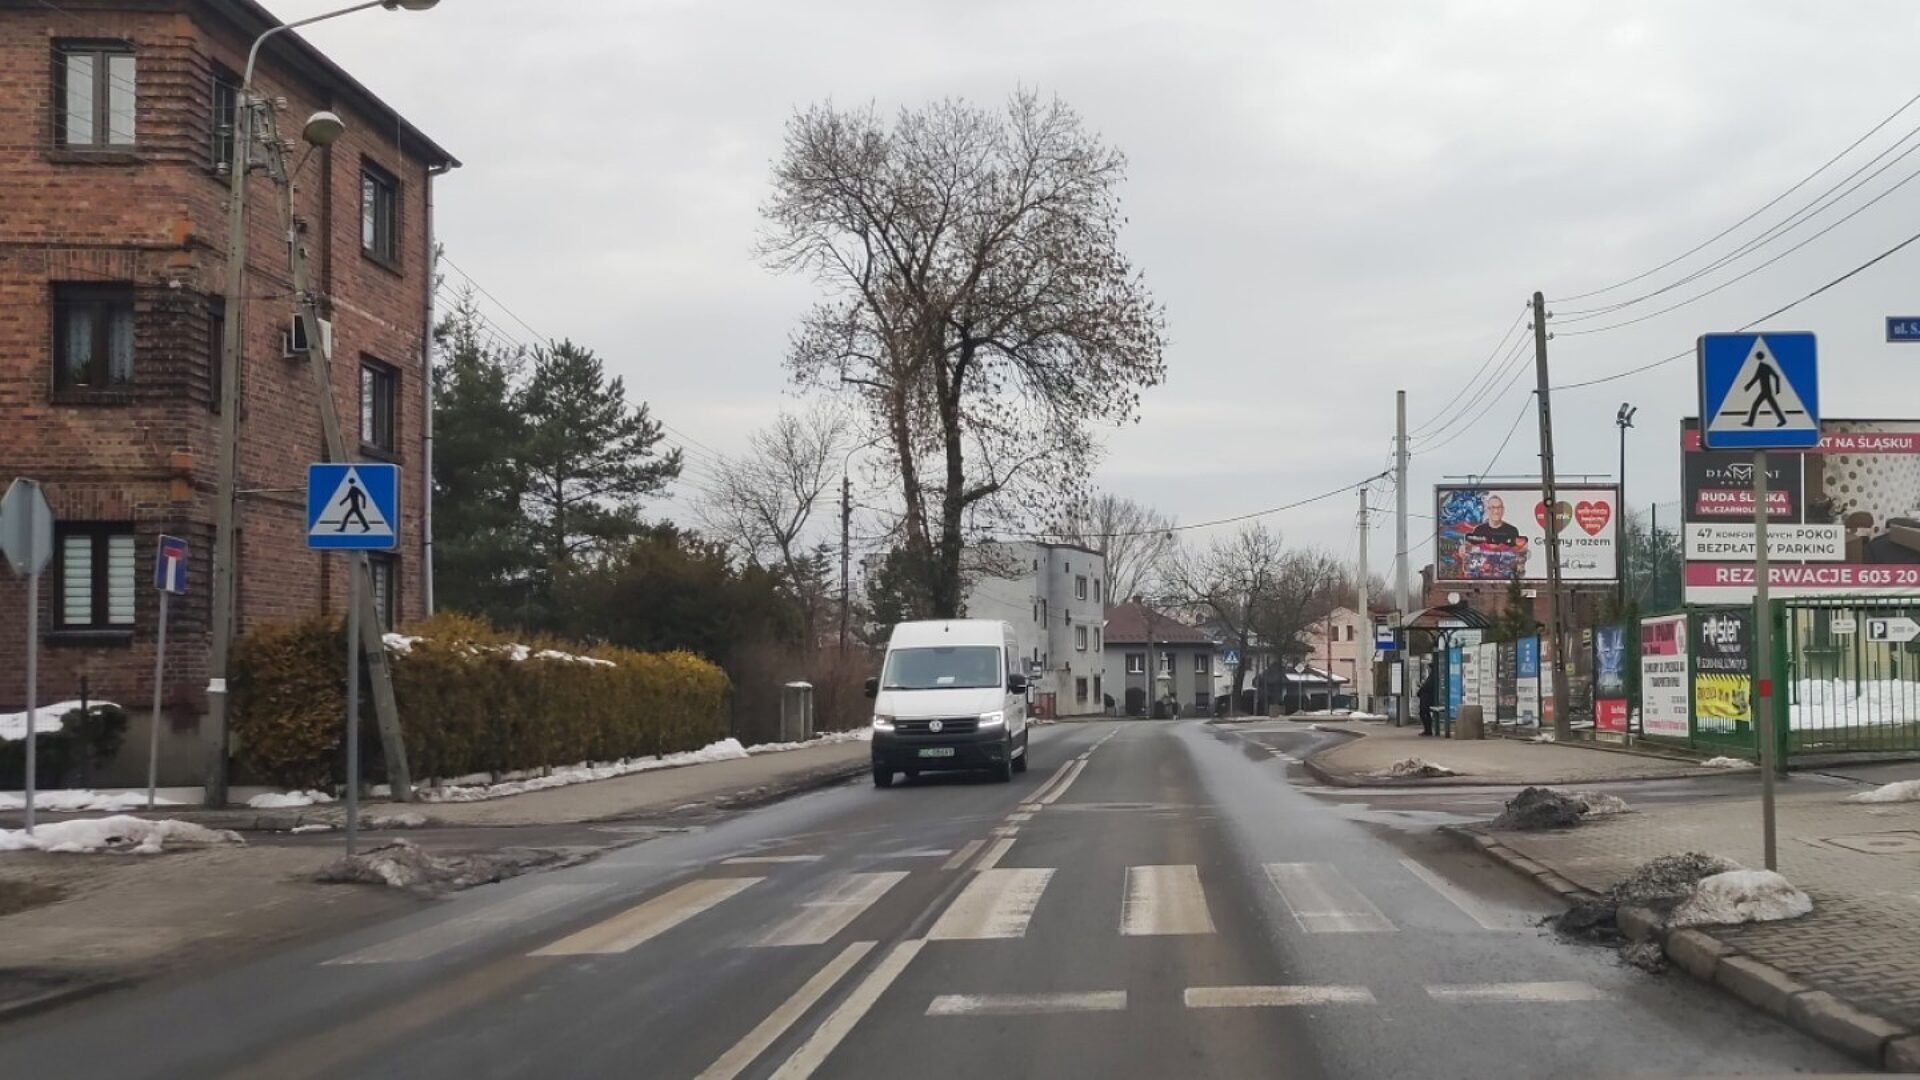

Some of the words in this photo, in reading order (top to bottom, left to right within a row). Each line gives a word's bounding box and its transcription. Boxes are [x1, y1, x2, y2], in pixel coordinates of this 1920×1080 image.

[1835, 438, 1855, 449] NA
[1857, 435, 1913, 451] ŚLĄSKU!
[1706, 464, 1780, 480] DIAMNT
[1701, 492, 1735, 502] RUDA
[1739, 490, 1786, 502] ŚLKA
[1697, 528, 1712, 539] 47
[1715, 531, 1793, 539] KOMFORWYCH
[1796, 529, 1838, 540] POKOI
[1697, 543, 1774, 553] BEZPŁATY
[1777, 544, 1836, 554] PARKING
[1715, 568, 1853, 583] REZRWACJE
[1858, 570, 1891, 583] 603
[1872, 622, 1885, 638] P
